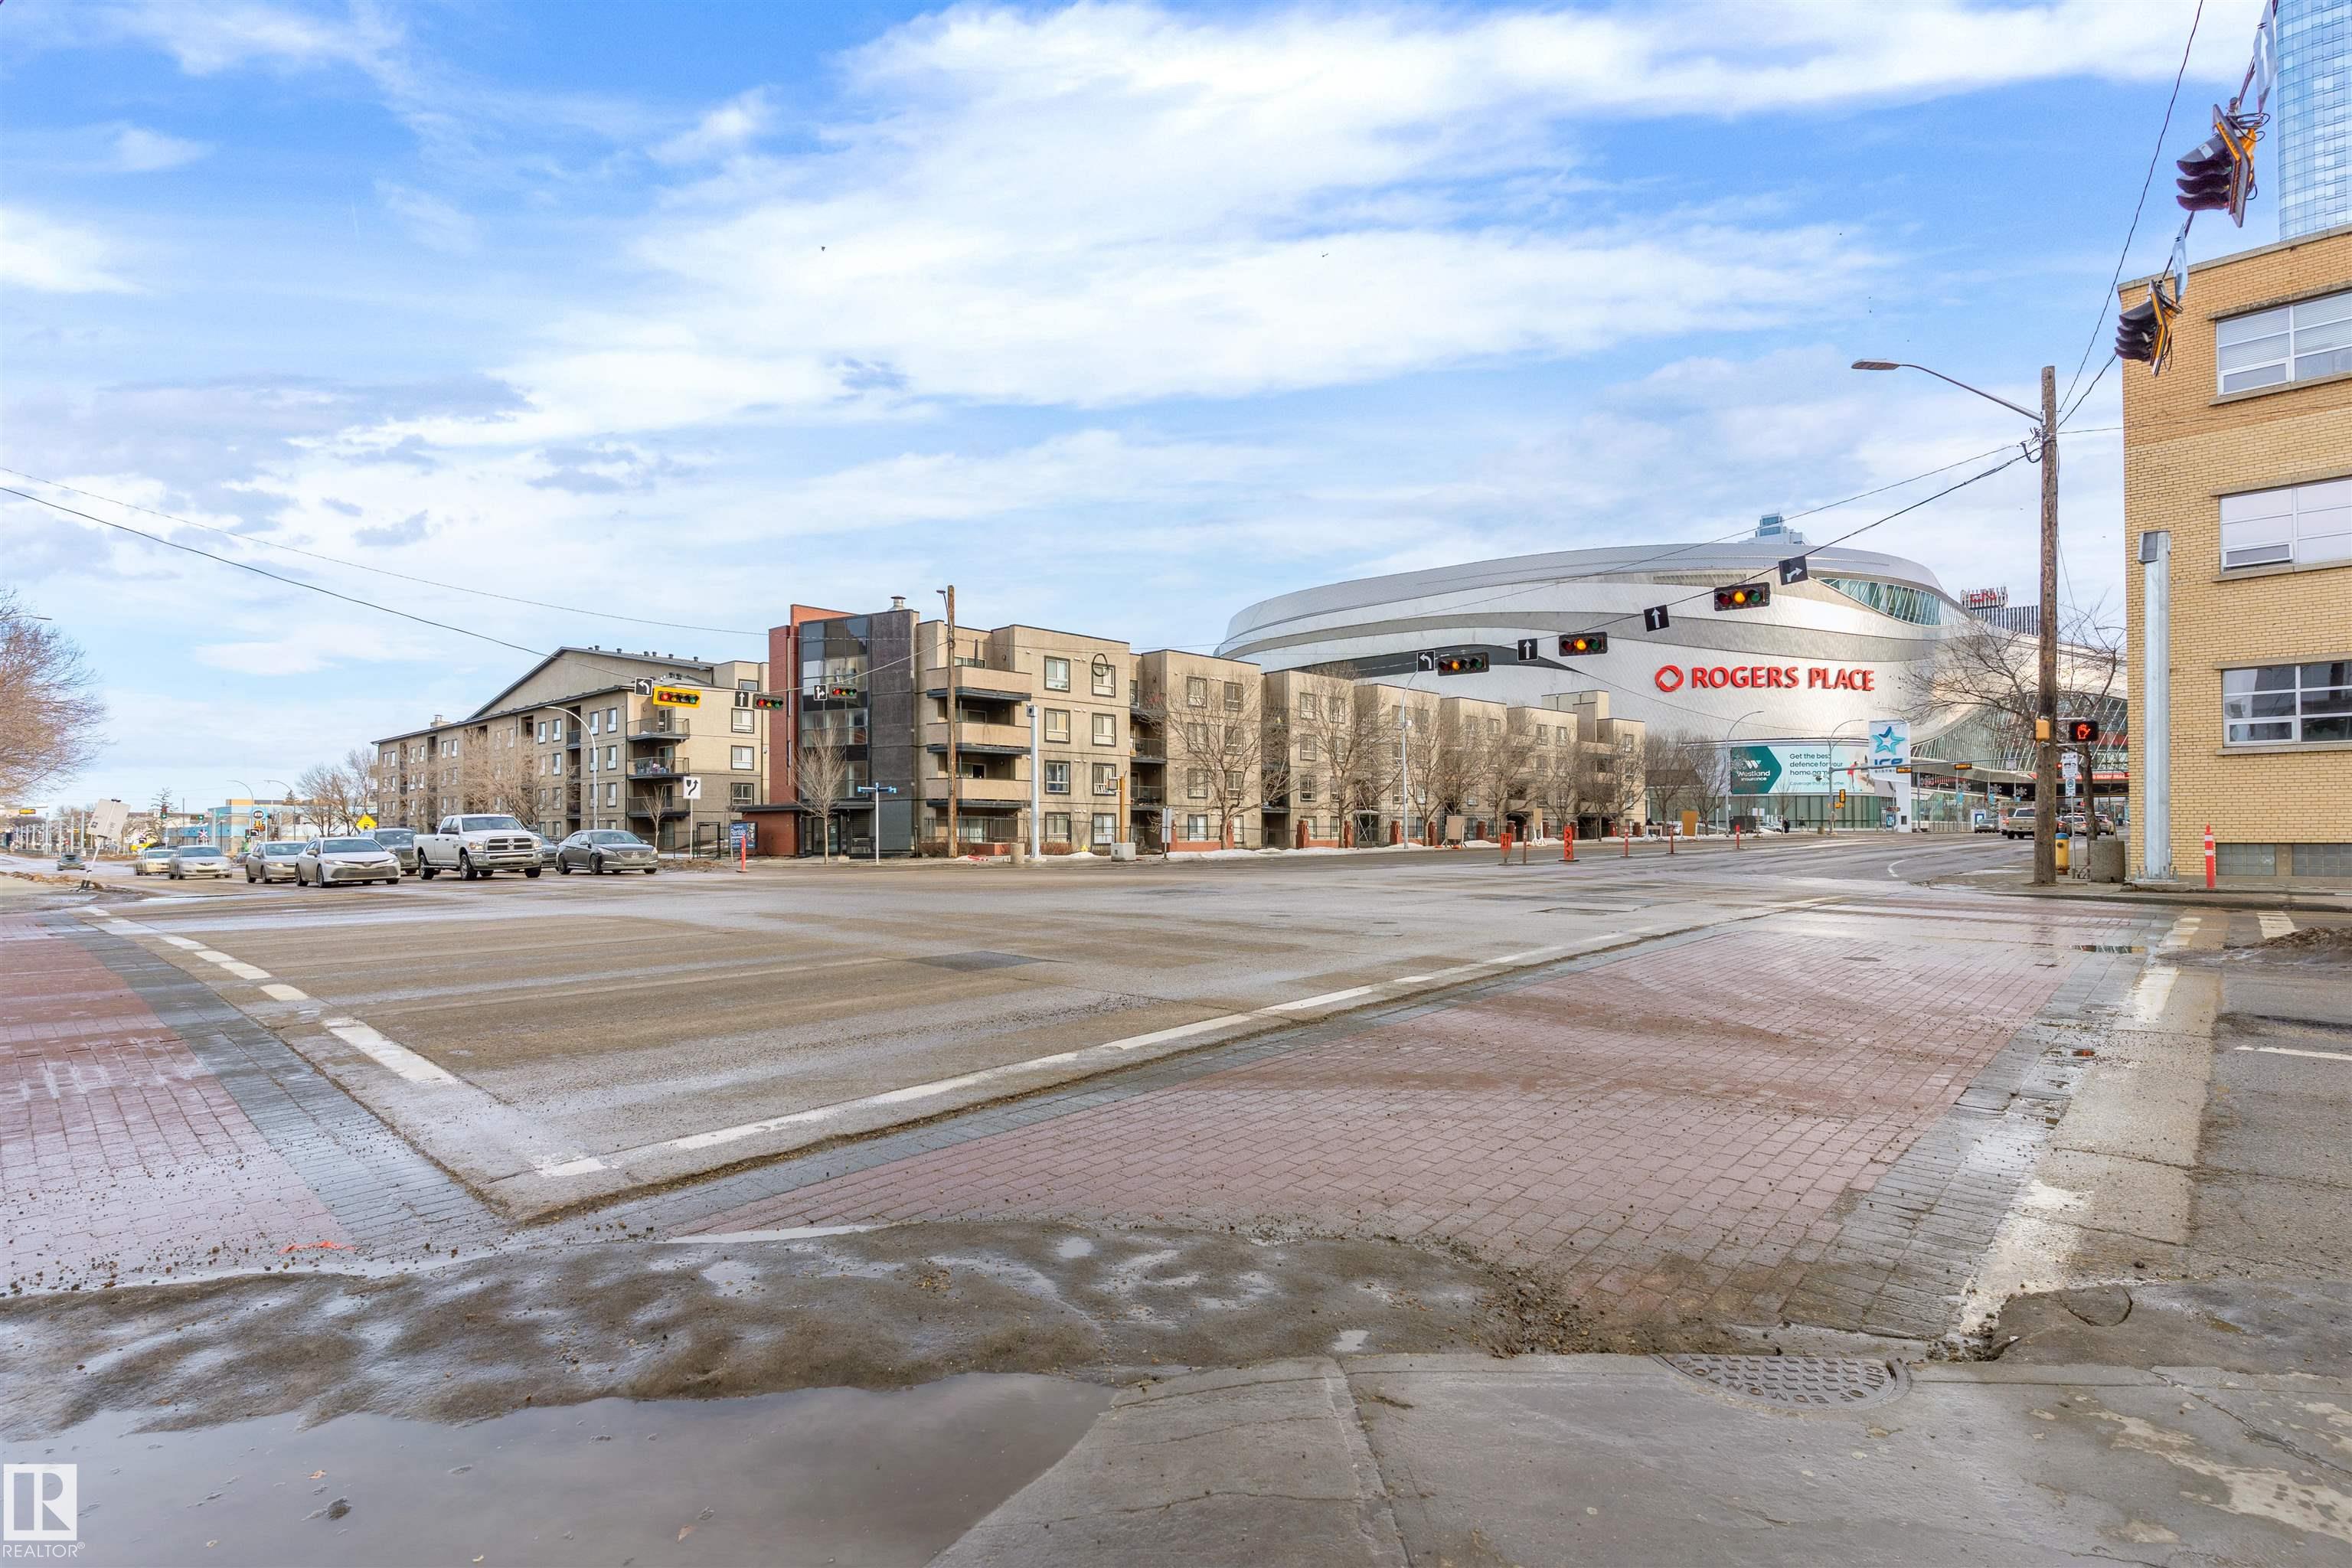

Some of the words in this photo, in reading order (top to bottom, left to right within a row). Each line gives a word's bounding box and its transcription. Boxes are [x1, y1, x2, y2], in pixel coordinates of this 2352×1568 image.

[1691, 666, 1799, 689] ROGERS
[1808, 667, 1875, 691] PLACE
[1862, 1365, 1885, 1391] CITY
[1839, 1389, 1868, 1402] OF
